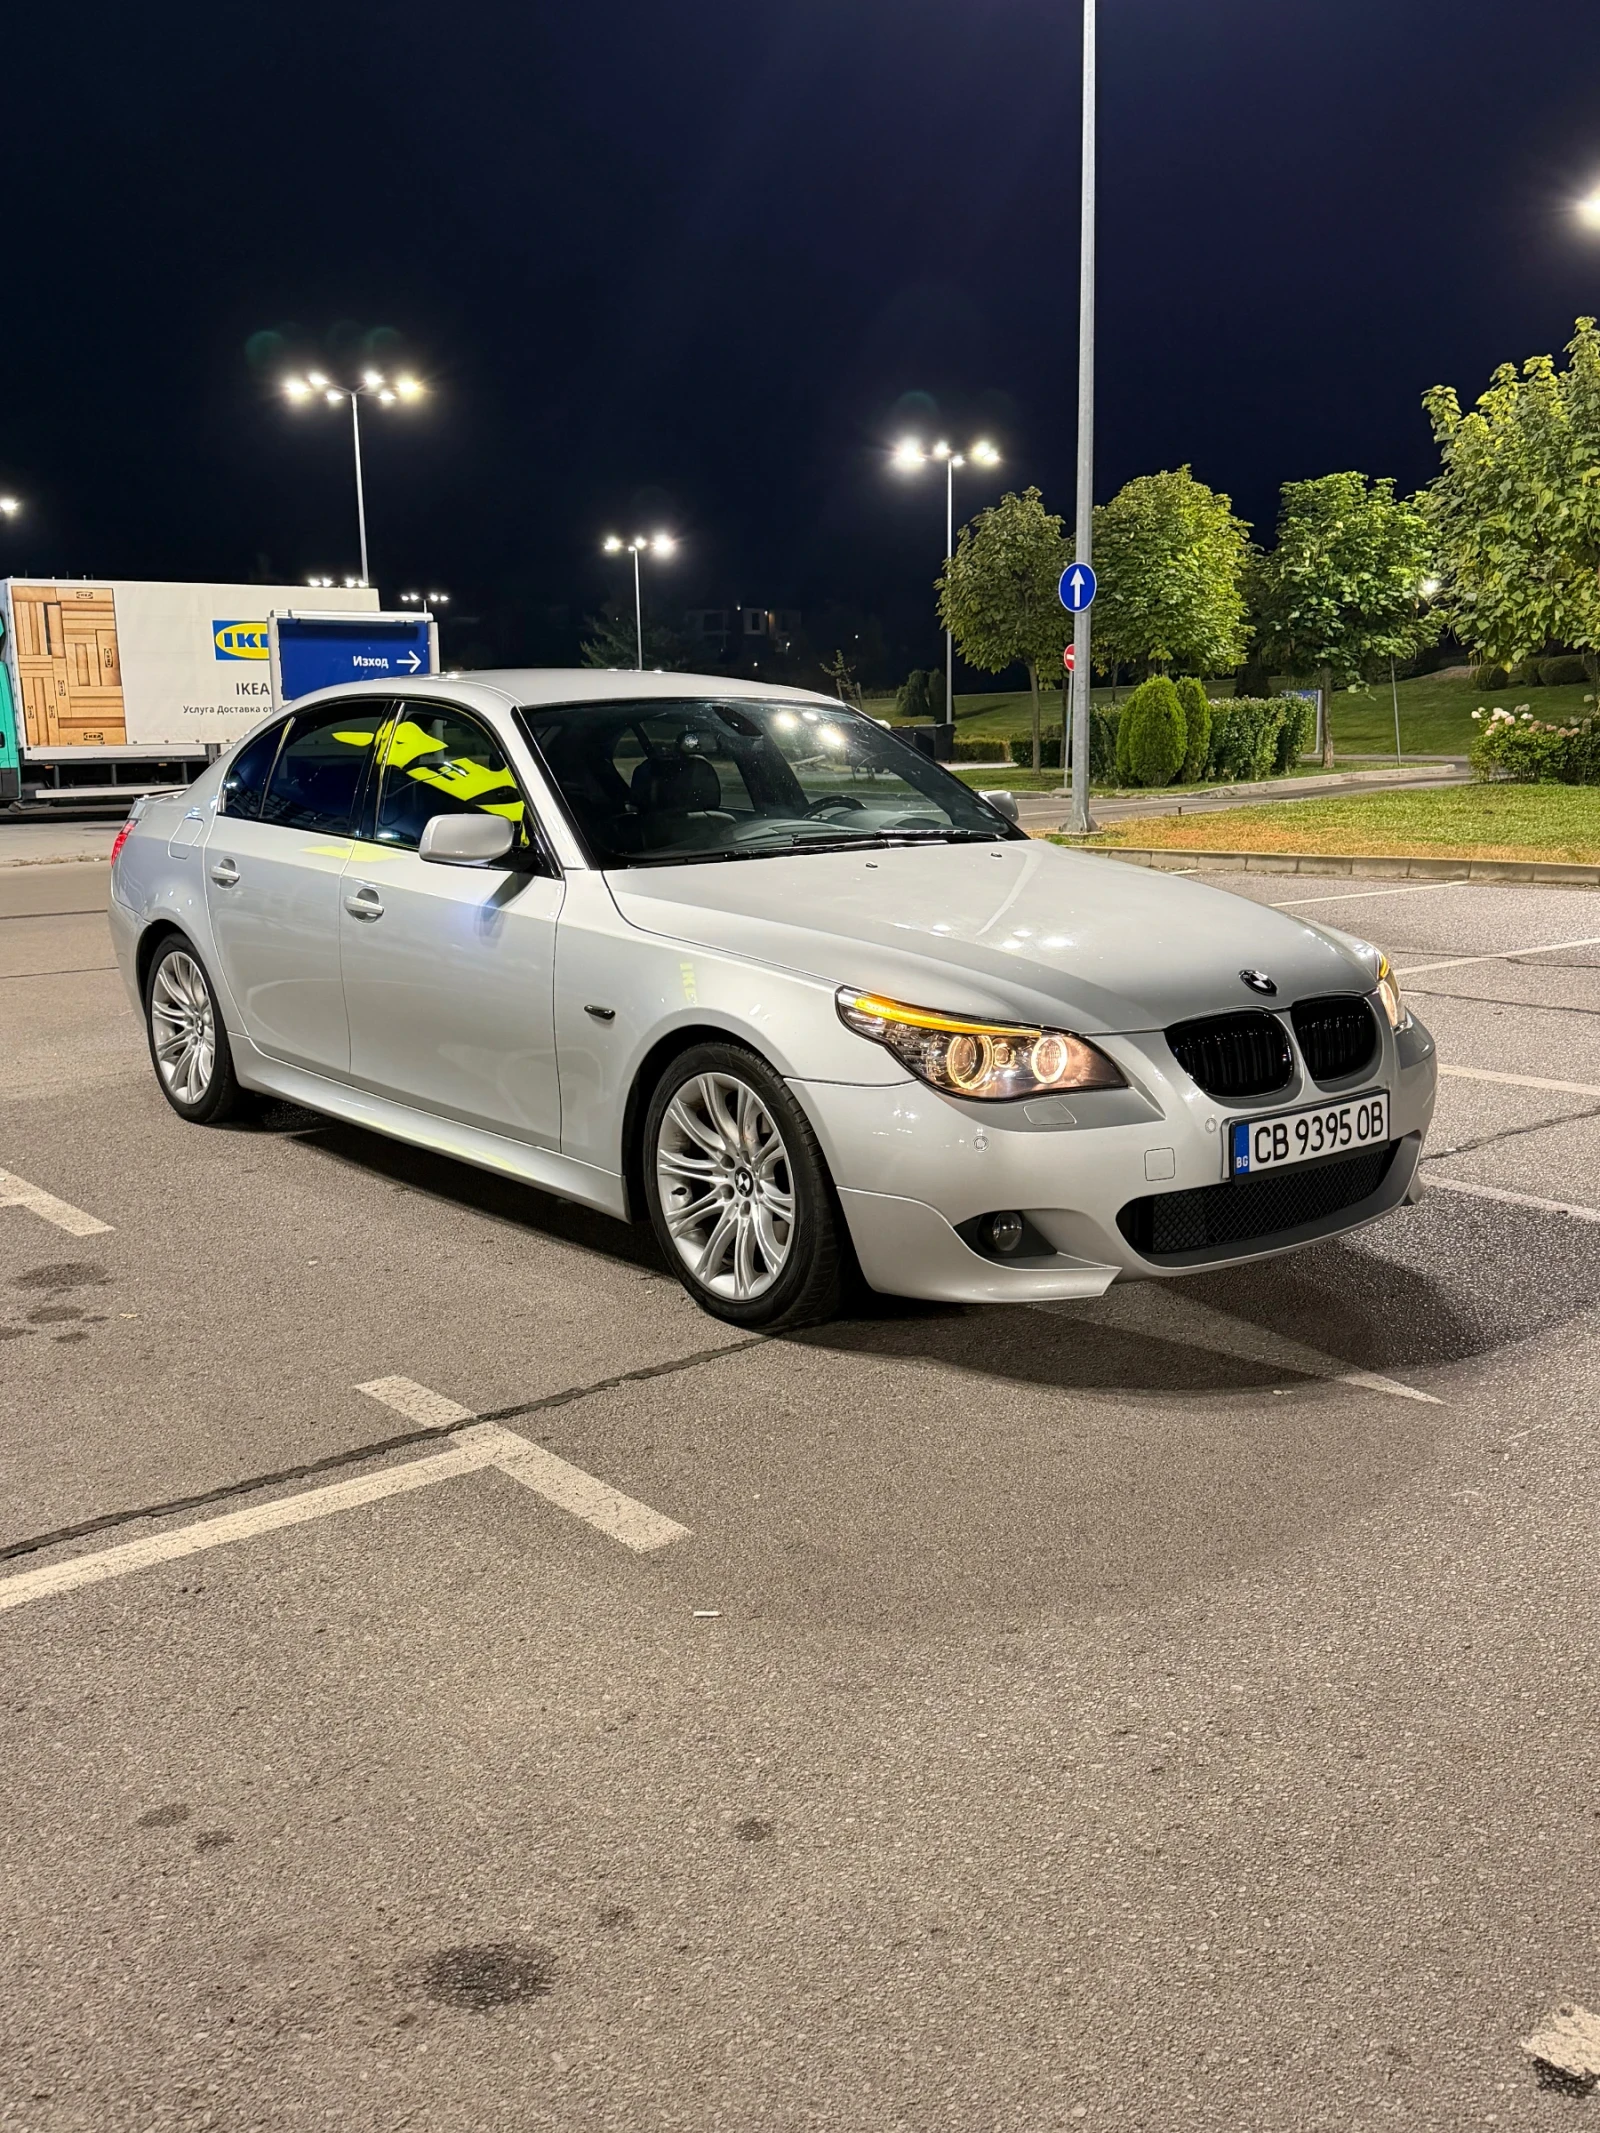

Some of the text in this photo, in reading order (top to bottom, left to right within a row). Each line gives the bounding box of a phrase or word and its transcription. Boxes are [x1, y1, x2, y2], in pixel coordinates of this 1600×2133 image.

[353, 655, 389, 669] Изход
[236, 682, 270, 695] IKEA
[183, 705, 215, 715] Услуга
[217, 705, 260, 715] Доставка
[1254, 1123, 1289, 1164] CB
[1295, 1108, 1352, 1156] 9395
[1236, 1155, 1249, 1168] BG
